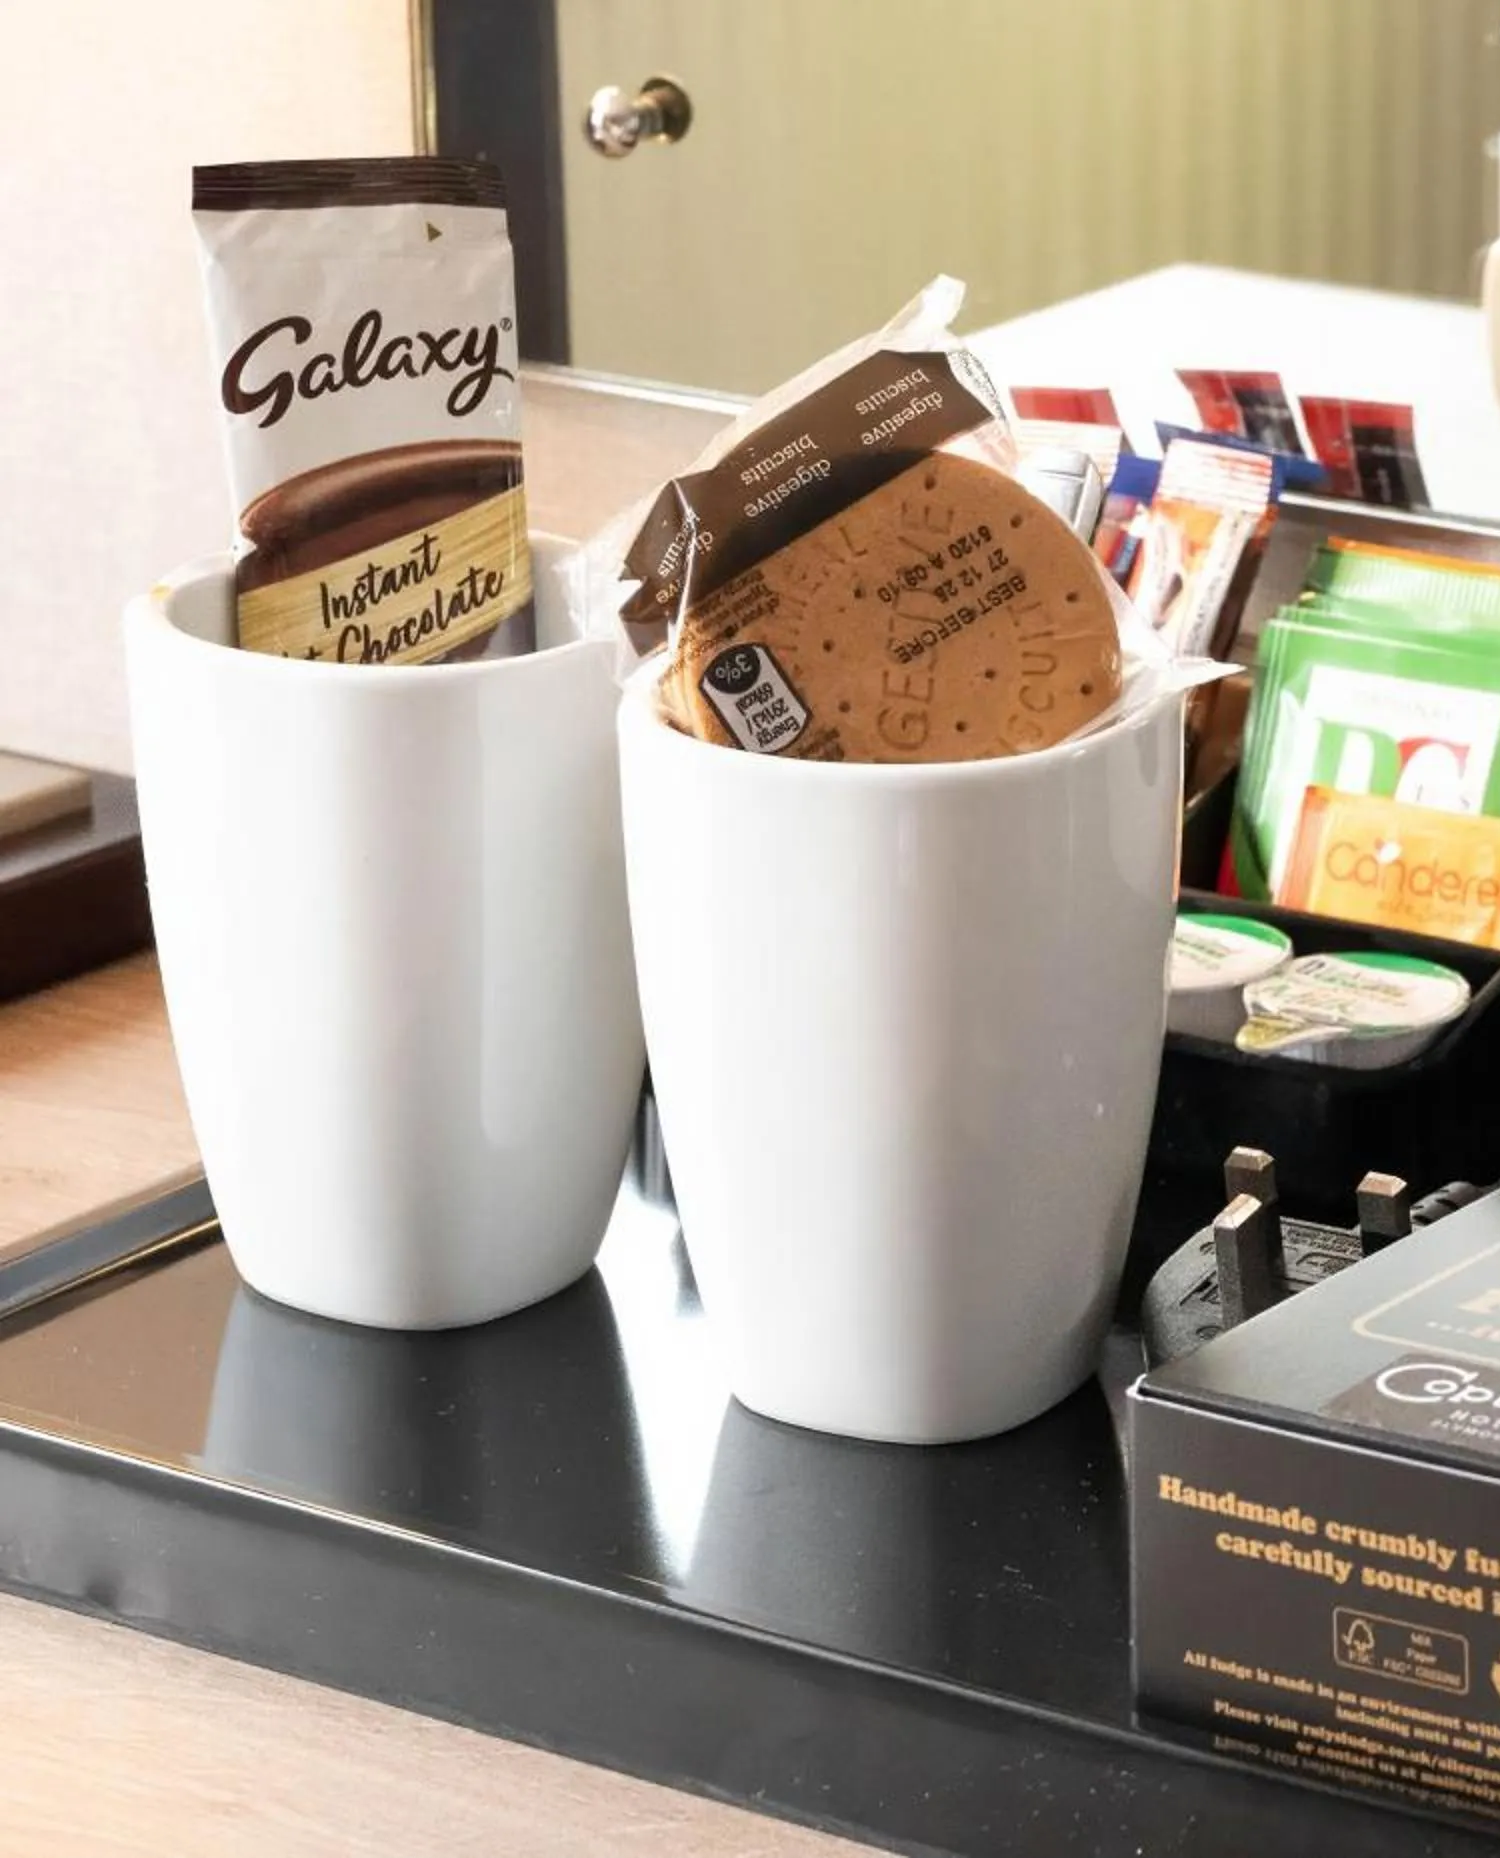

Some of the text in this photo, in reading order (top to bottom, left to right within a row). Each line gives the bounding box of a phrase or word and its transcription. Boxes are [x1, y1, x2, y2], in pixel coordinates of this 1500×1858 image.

[855, 369, 930, 415] biscuits
[861, 391, 943, 445] digestive
[740, 433, 819, 485] biscuits
[743, 459, 831, 518] digestive
[320, 533, 441, 629] Instant
[957, 565, 983, 587] 12
[988, 548, 1009, 573] 27
[338, 567, 504, 664] Chocolate
[894, 575, 1027, 664] BEST BEFORE
[715, 653, 751, 685] 3%
[758, 715, 800, 748] Energy
[1158, 1473, 1318, 1535] Handmade
[1325, 1519, 1457, 1572] crumbly
[1216, 1531, 1354, 1584] carefully
[1361, 1566, 1483, 1612] sourced
[1184, 1650, 1207, 1669] All
[1210, 1656, 1253, 1680] fudge
[1257, 1668, 1271, 1684] is
[1274, 1673, 1314, 1693] made
[1318, 1682, 1334, 1699] in
[1337, 1690, 1357, 1705] an
[1360, 1696, 1461, 1730] environment
[1214, 1700, 1261, 1724] Please
[1265, 1712, 1299, 1733] visit
[1336, 1704, 1410, 1737] including
[1413, 1725, 1449, 1745] nuts
[1453, 1736, 1482, 1753] and
[1296, 1740, 1315, 1754] or
[1317, 1745, 1376, 1770] contact
[1378, 1759, 1397, 1775] us
[1400, 1764, 1418, 1780] at
